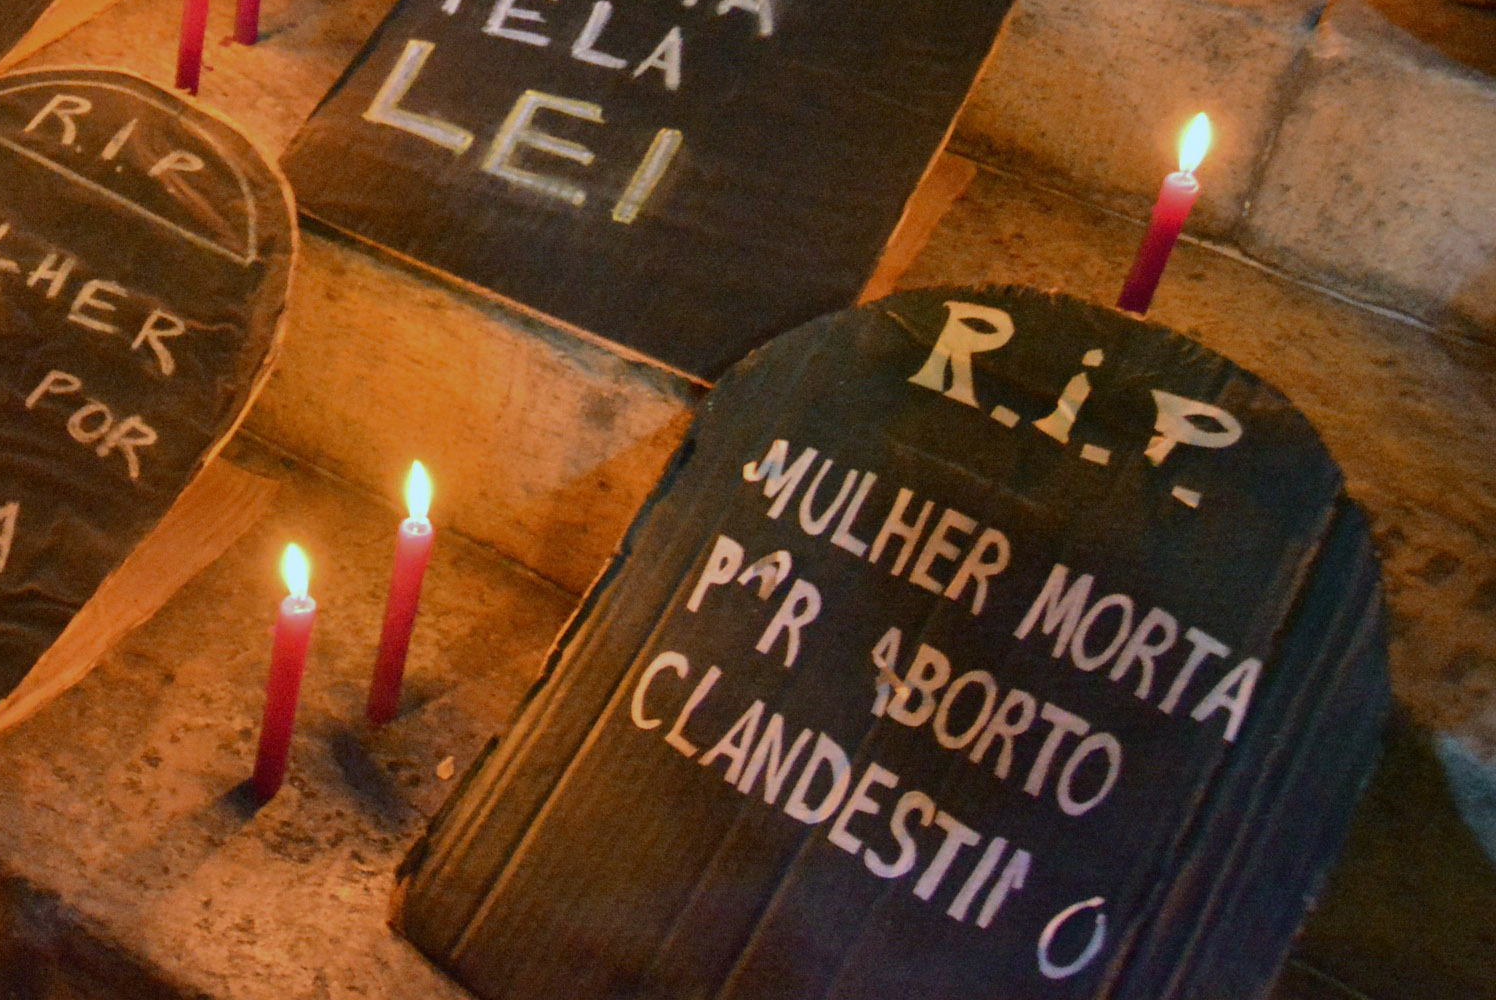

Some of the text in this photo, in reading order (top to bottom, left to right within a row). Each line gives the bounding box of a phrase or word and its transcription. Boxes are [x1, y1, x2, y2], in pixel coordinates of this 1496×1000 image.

[362, 39, 685, 225] LEI
[23, 369, 160, 480] POR
[741, 437, 1266, 743] MULHER MORTA
[870, 625, 1125, 818] ABORTO
